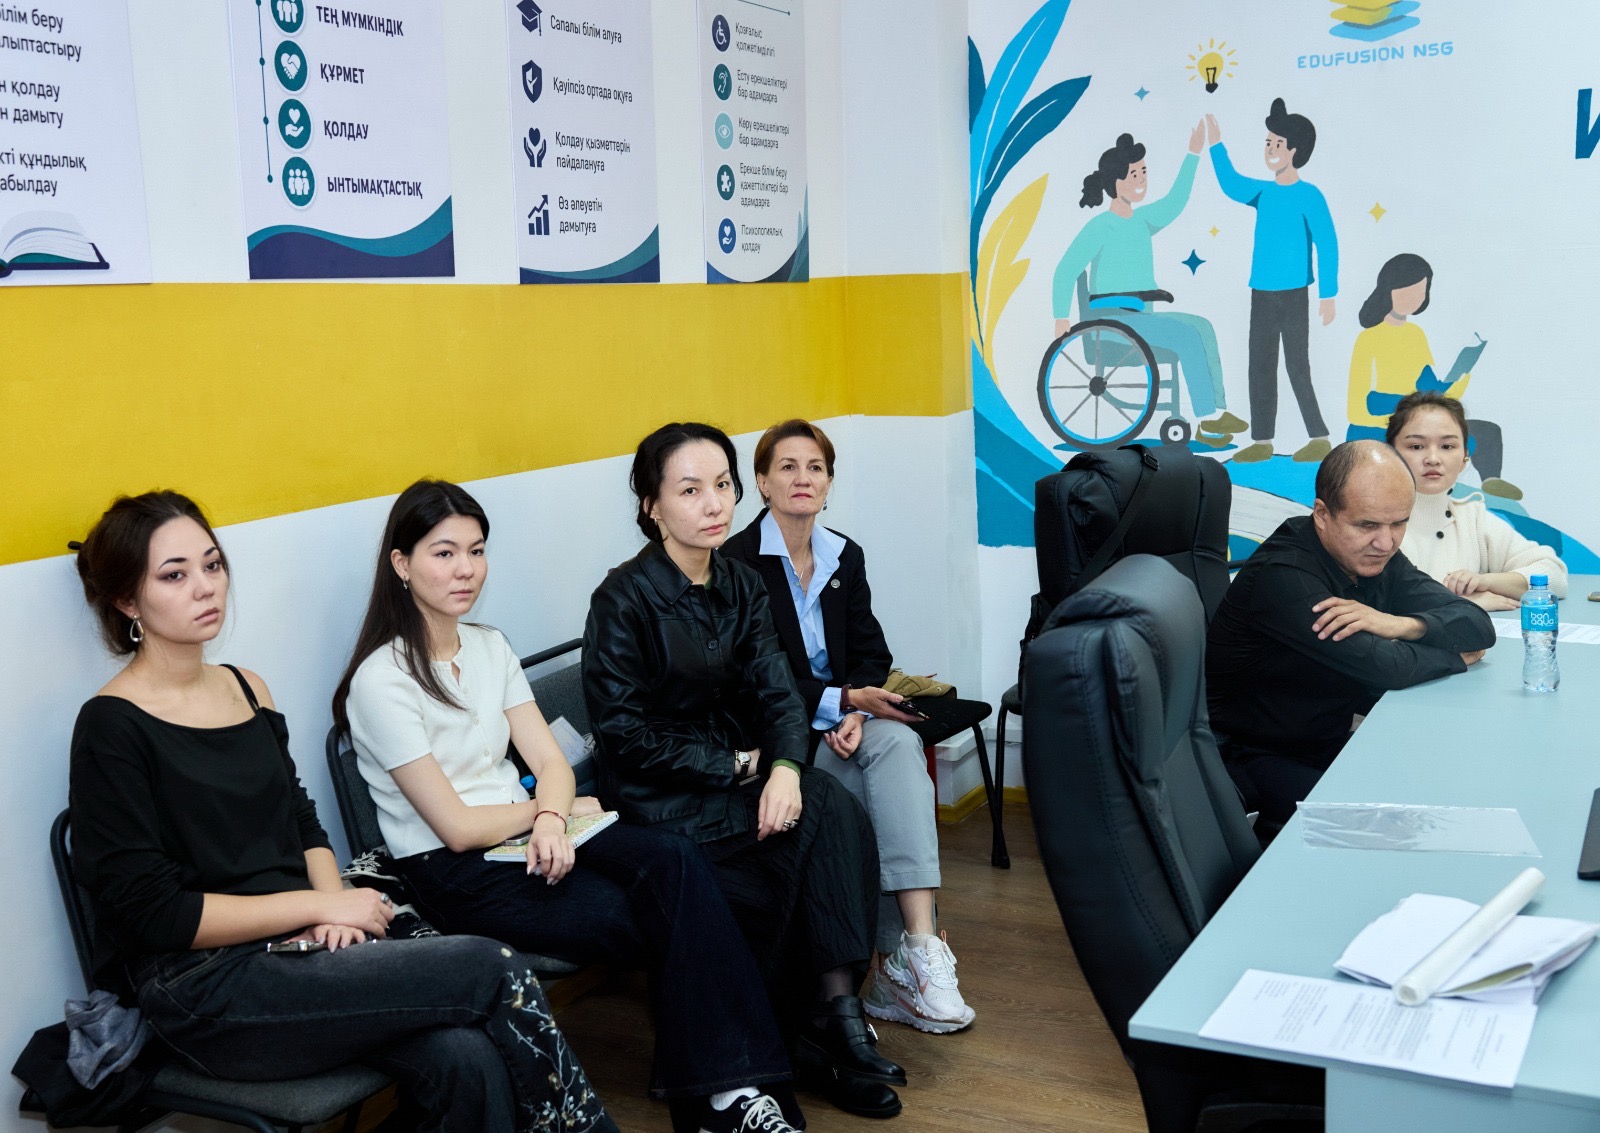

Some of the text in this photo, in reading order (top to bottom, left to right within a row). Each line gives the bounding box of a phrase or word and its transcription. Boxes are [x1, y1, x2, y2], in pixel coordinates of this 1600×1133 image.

[0, 4, 63, 33] ілім беру
[316, 6, 404, 37] ТЕҢ МҮМКІНДІК
[550, 14, 622, 45] Сапалы білім алуға
[0, 36, 81, 62] лыптастыру
[1297, 41, 1454, 69] EDUFUSION NSG
[320, 62, 365, 84] ҚҰРМЕТ
[11, 80, 60, 102] қолдау
[553, 76, 633, 104] Қауіпсіз ортада оқуға
[13, 107, 64, 129] дамыту
[324, 120, 369, 141] ҚОЛДАУ
[555, 131, 631, 155] Қолдау қызметтерін
[20, 152, 87, 172] құндылық
[556, 154, 605, 174] пайдалануға
[327, 176, 423, 199] ЫНТЫМАҚТАСТЫҚ
[558, 195, 603, 215] Өз әлеуетін
[559, 220, 597, 236] дамытуға
